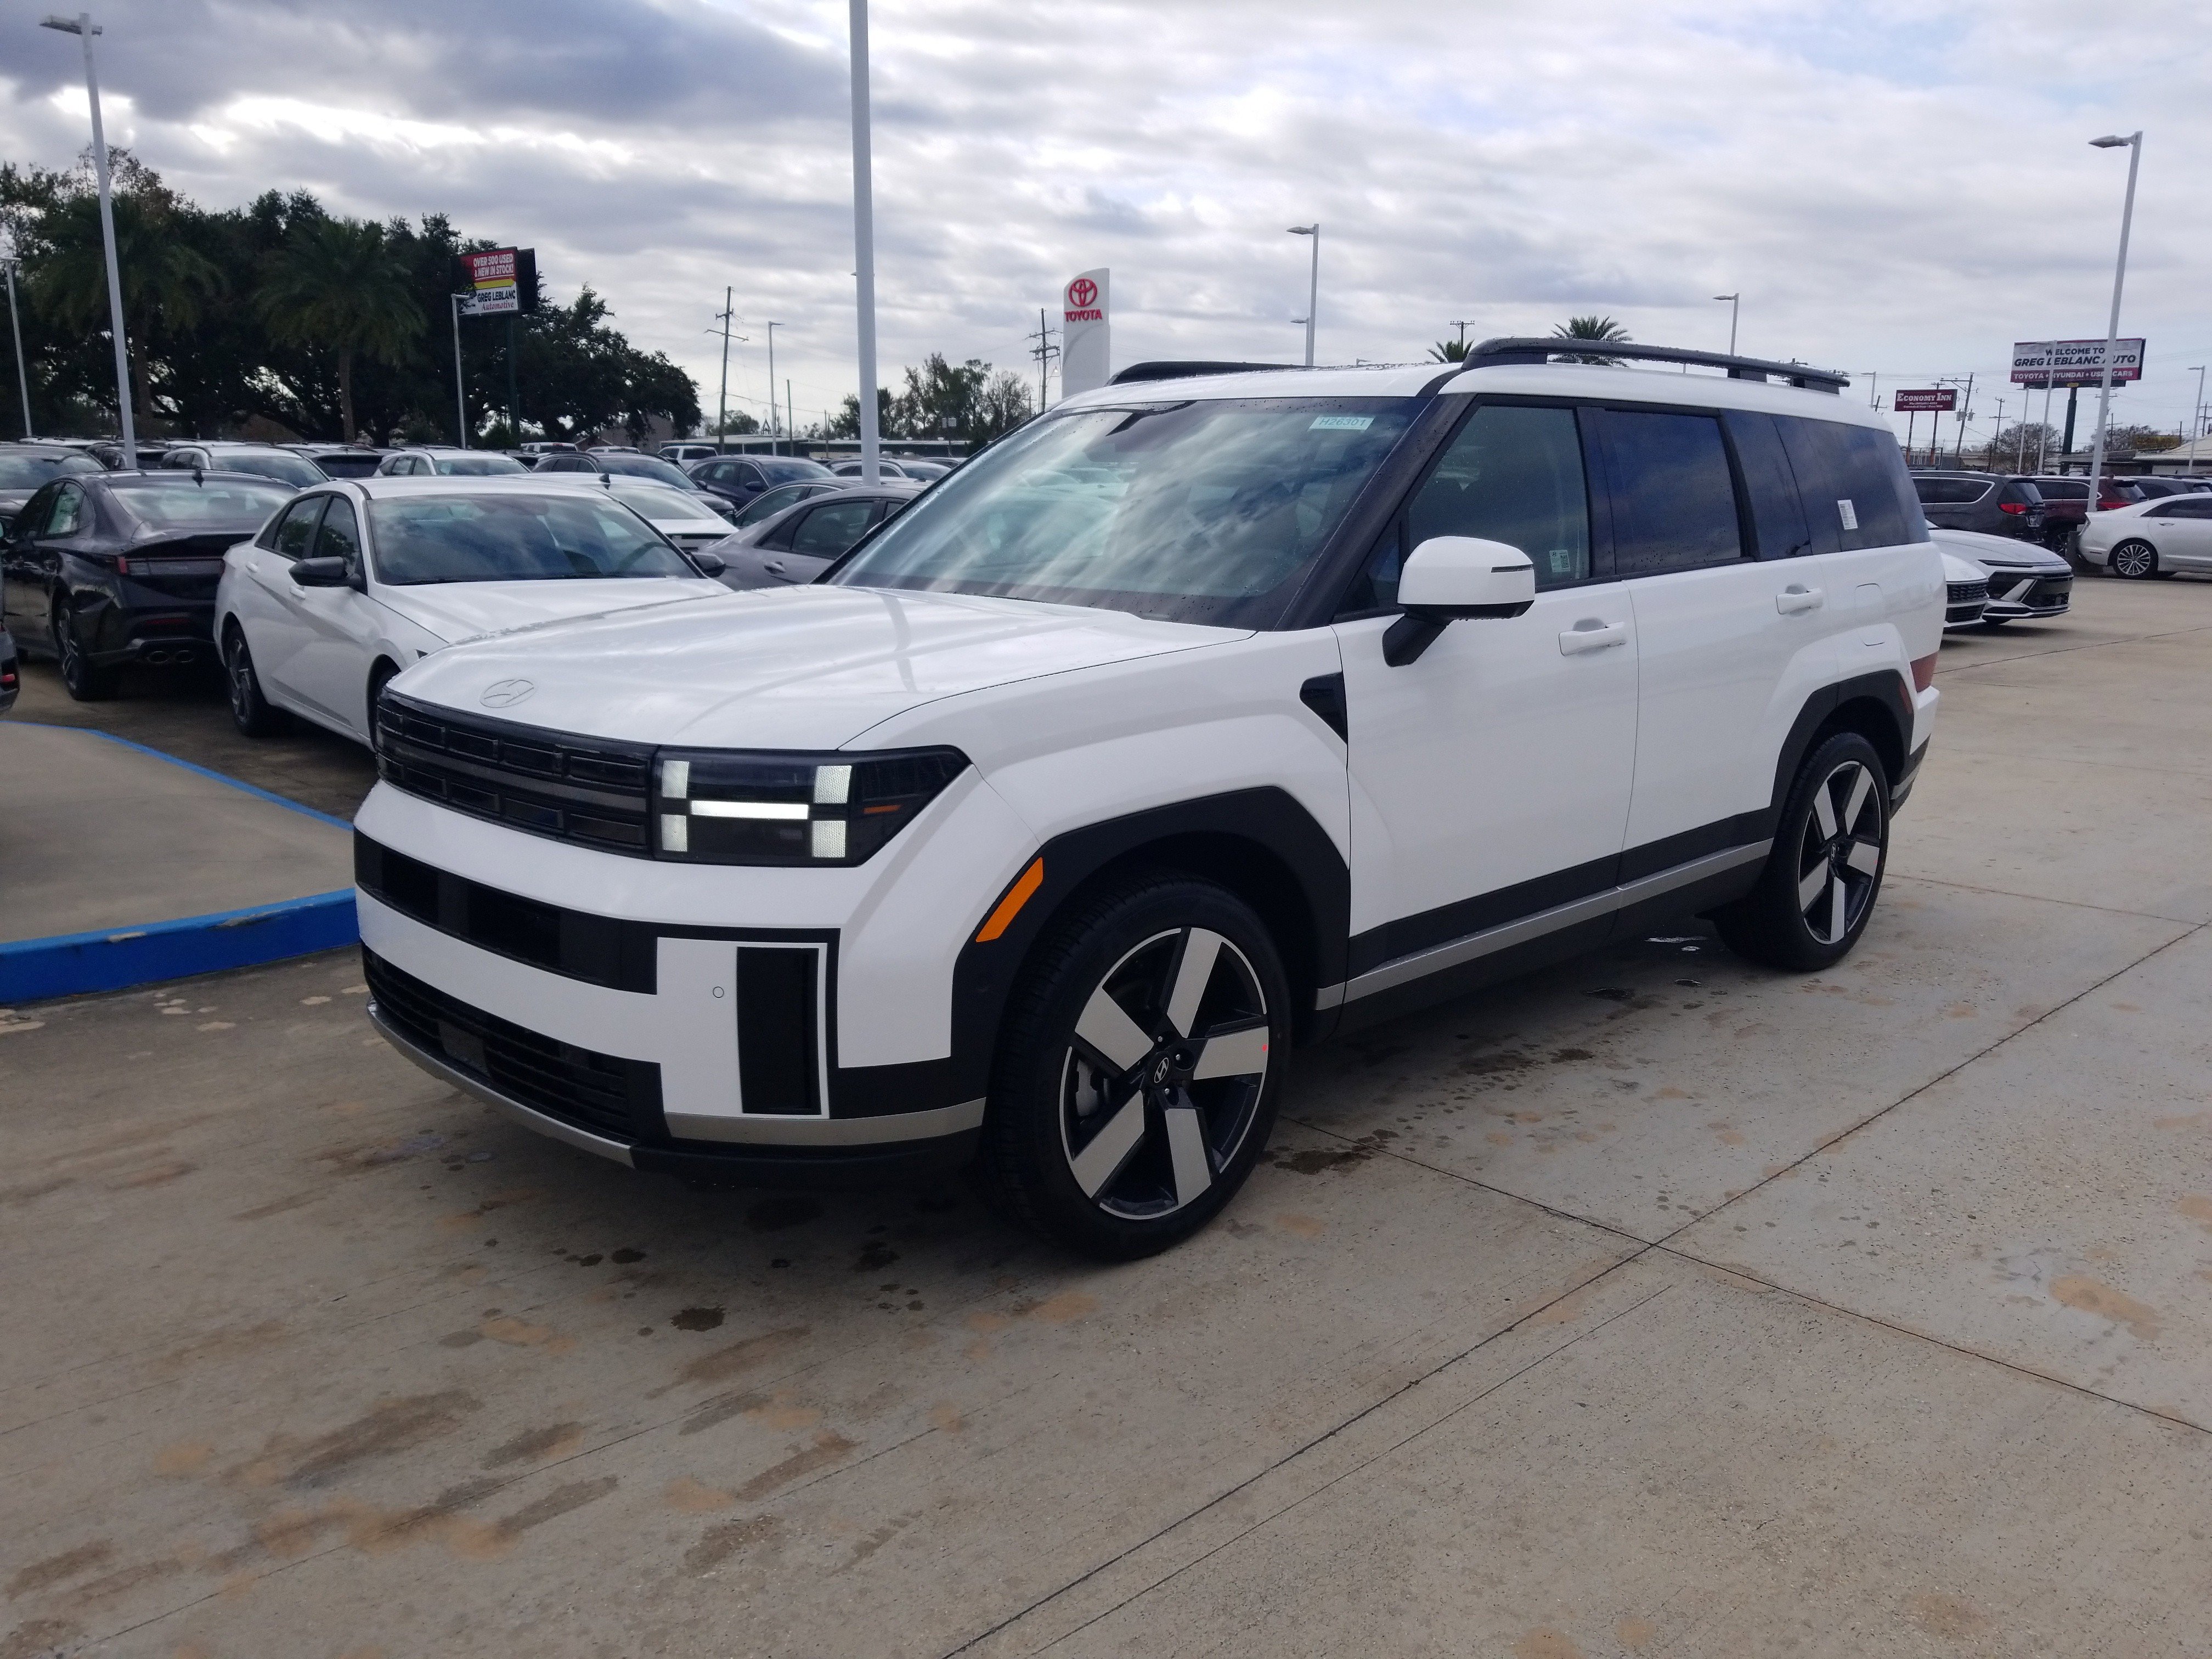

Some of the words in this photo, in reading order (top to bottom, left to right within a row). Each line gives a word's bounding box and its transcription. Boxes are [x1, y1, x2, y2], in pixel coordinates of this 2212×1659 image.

[473, 257, 487, 267] OVER
[488, 255, 499, 265] 500
[499, 253, 513, 263] USED
[478, 267, 490, 276] NEW
[490, 266, 495, 275] IN
[477, 292, 491, 302] GREG
[493, 290, 516, 300] LEBLANC
[482, 301, 514, 311] Automotive
[1065, 309, 1102, 322] TOYOTA
[2014, 357, 2045, 366] GREG
[2046, 356, 2101, 365] LEBLANC
[2102, 354, 2136, 364] UTO
[1897, 393, 1936, 402] ECONOMY
[1937, 392, 1952, 401] INN
